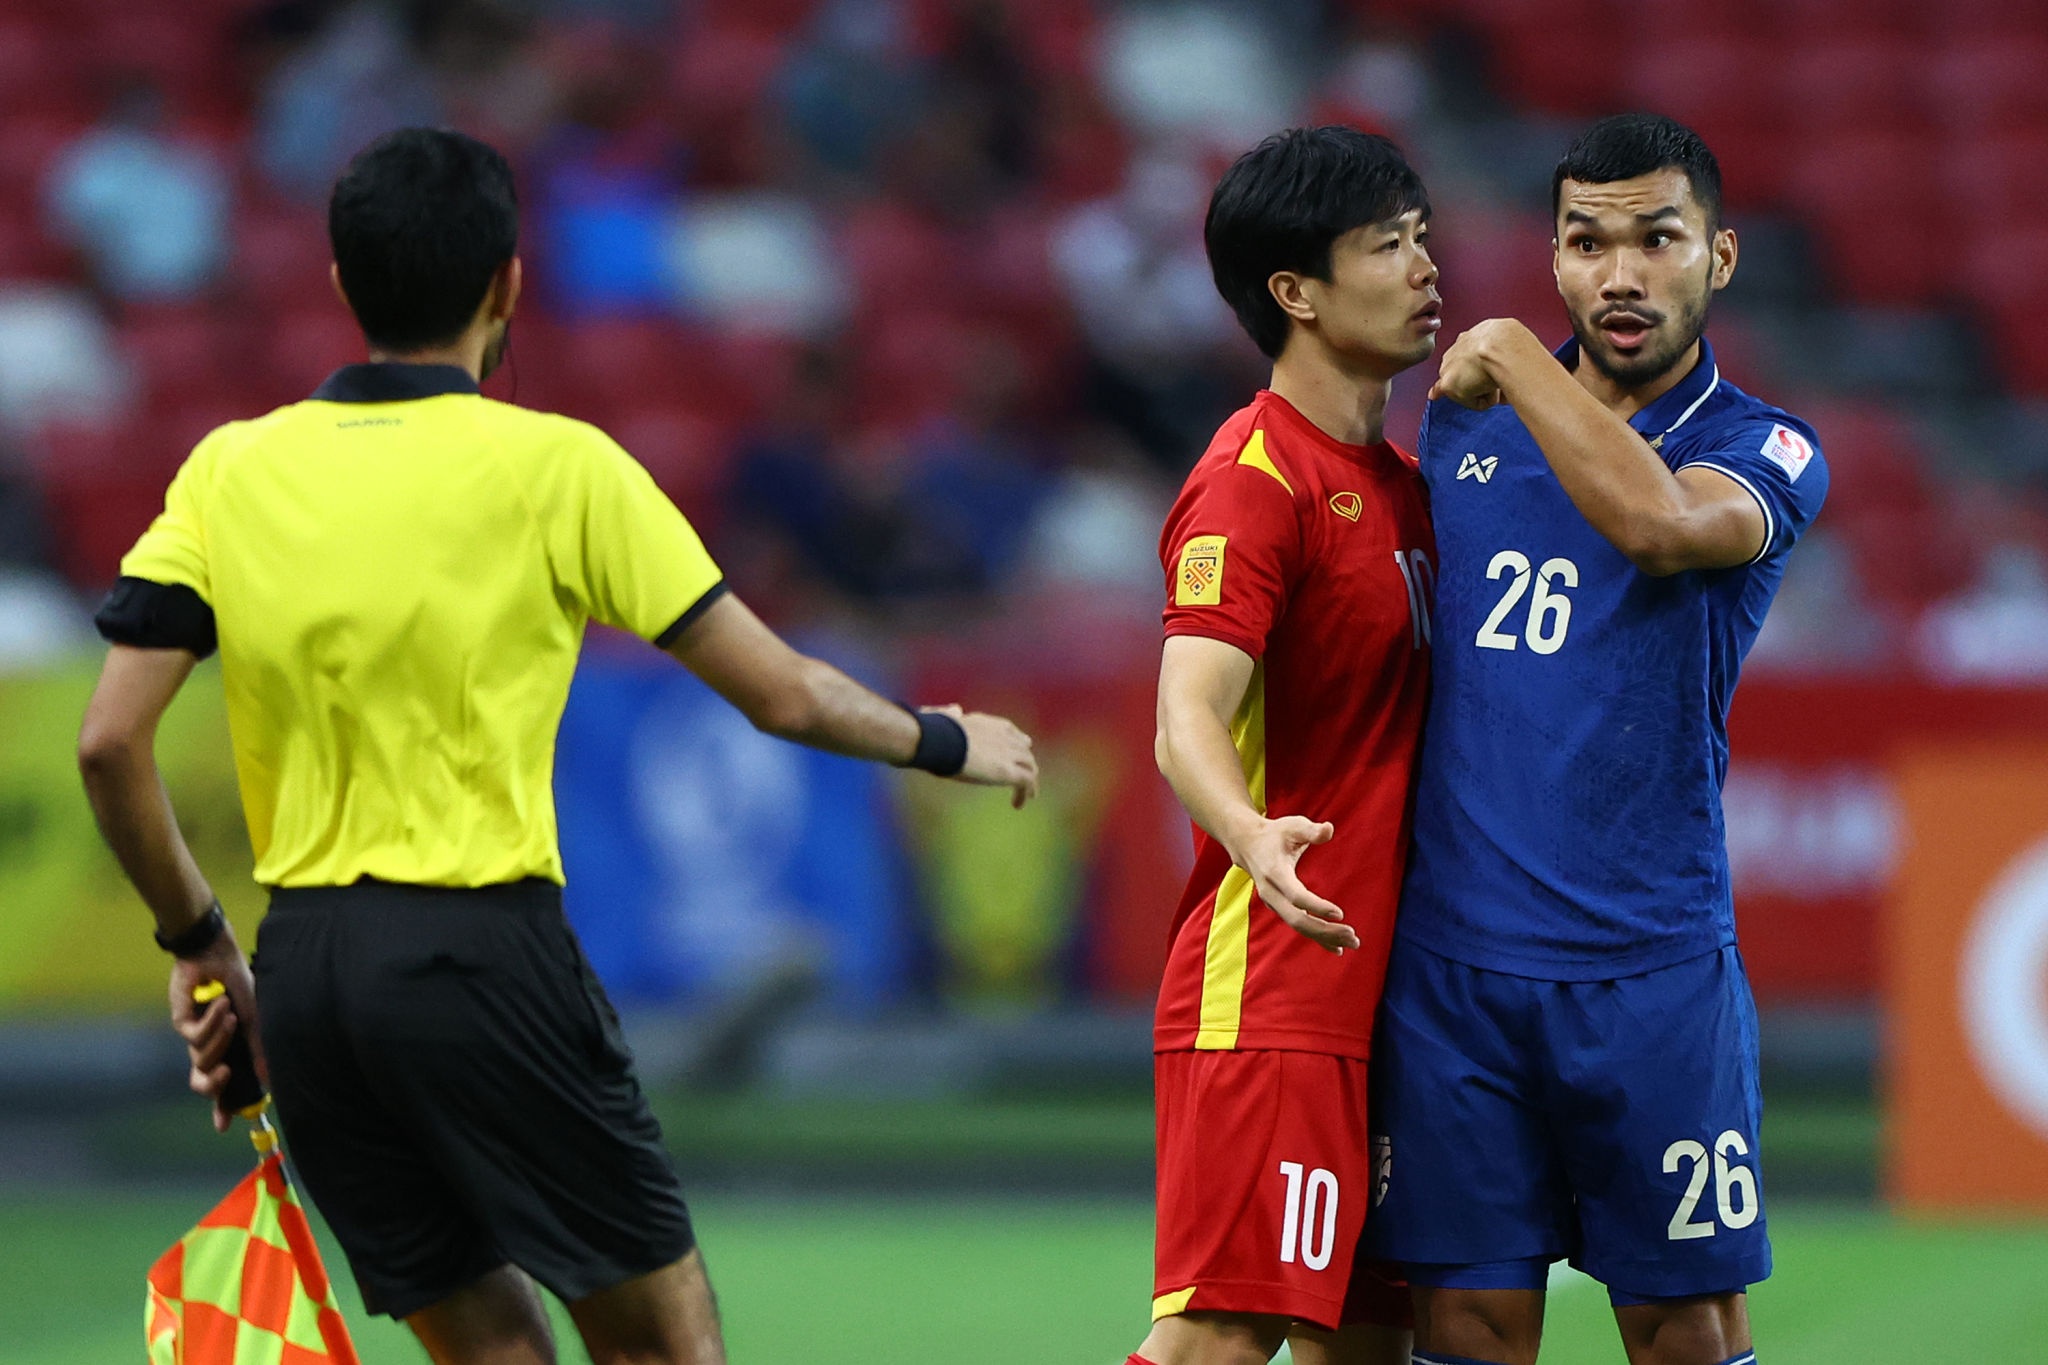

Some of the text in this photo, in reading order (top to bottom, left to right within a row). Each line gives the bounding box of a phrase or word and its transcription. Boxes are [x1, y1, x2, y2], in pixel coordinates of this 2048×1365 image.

[1394, 549, 1434, 649] 10
[1476, 550, 1579, 655] 26
[1280, 1161, 1339, 1271] 10
[1663, 1129, 1758, 1240] 26
